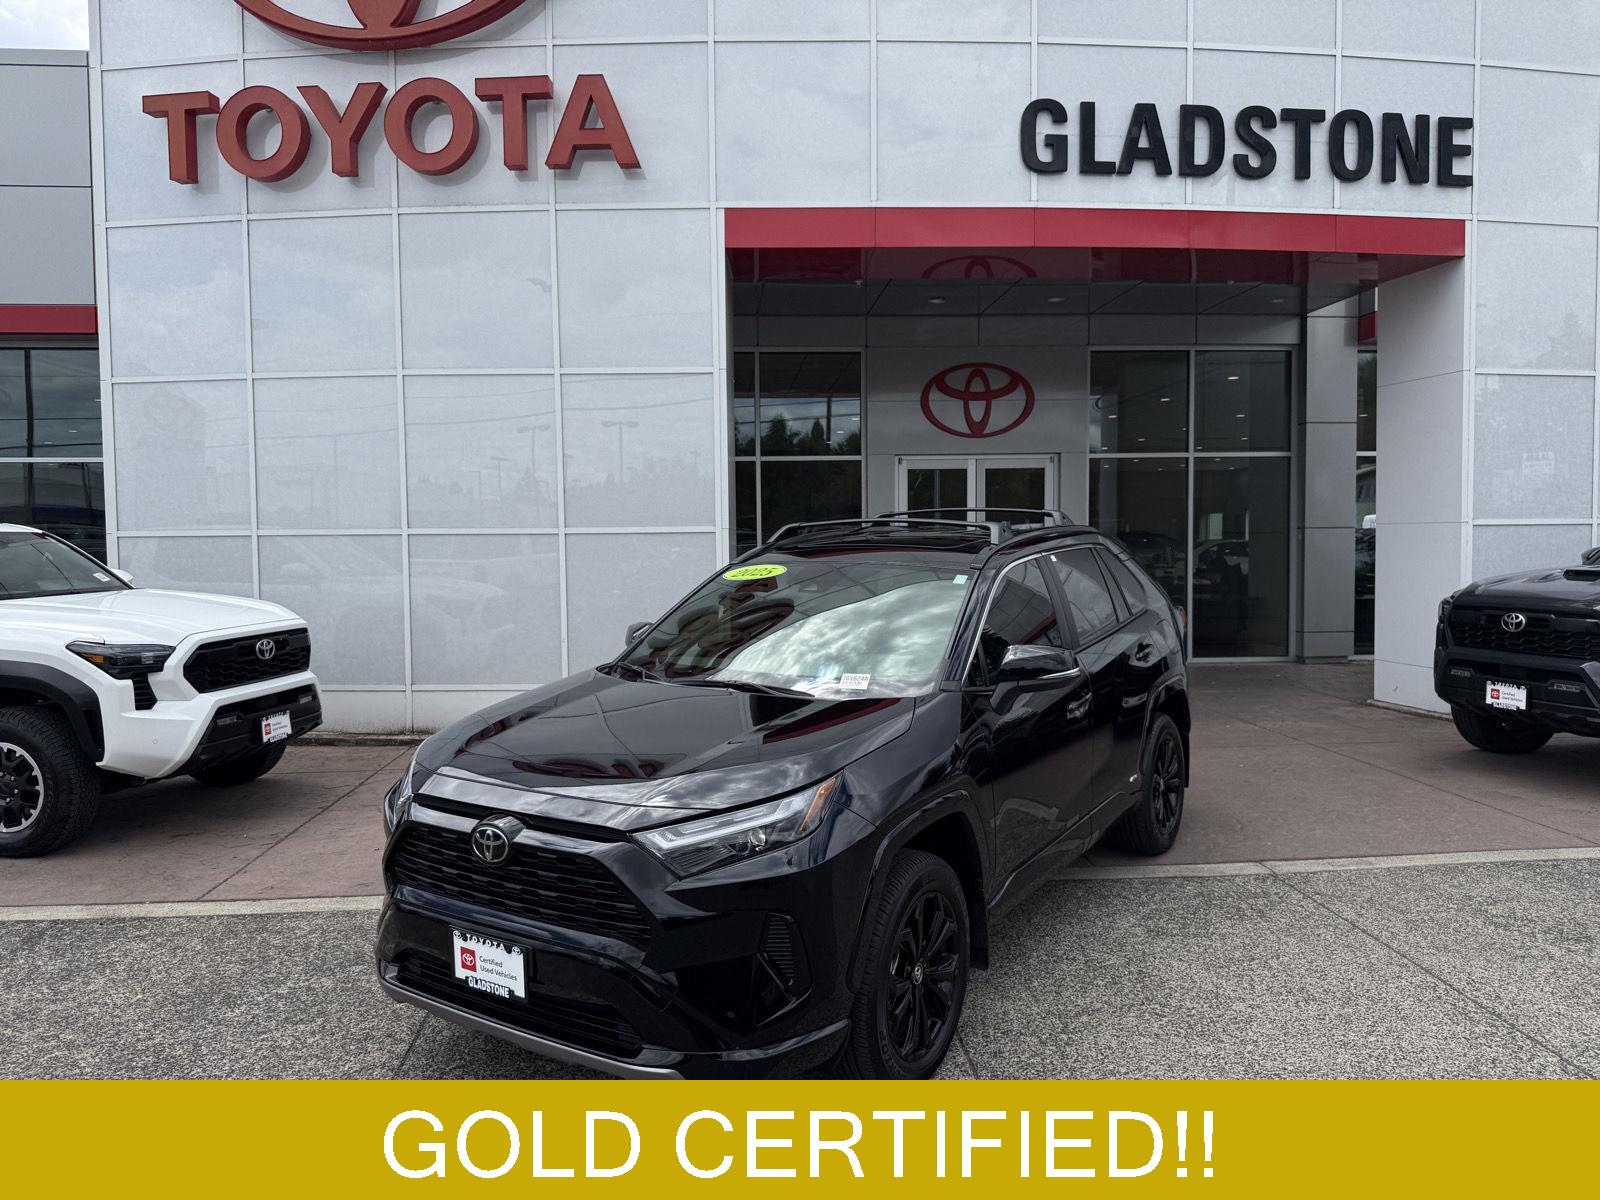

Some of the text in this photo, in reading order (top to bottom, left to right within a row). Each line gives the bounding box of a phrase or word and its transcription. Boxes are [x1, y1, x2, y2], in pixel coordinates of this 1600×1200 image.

[143, 75, 640, 184] TOYOTA
[1021, 98, 1474, 188] GLADSTONE
[466, 934, 506, 951] TOYOTA
[479, 955, 503, 968] Certified
[480, 965, 518, 982] Used Vehicles
[468, 976, 510, 999] GLADSTONE
